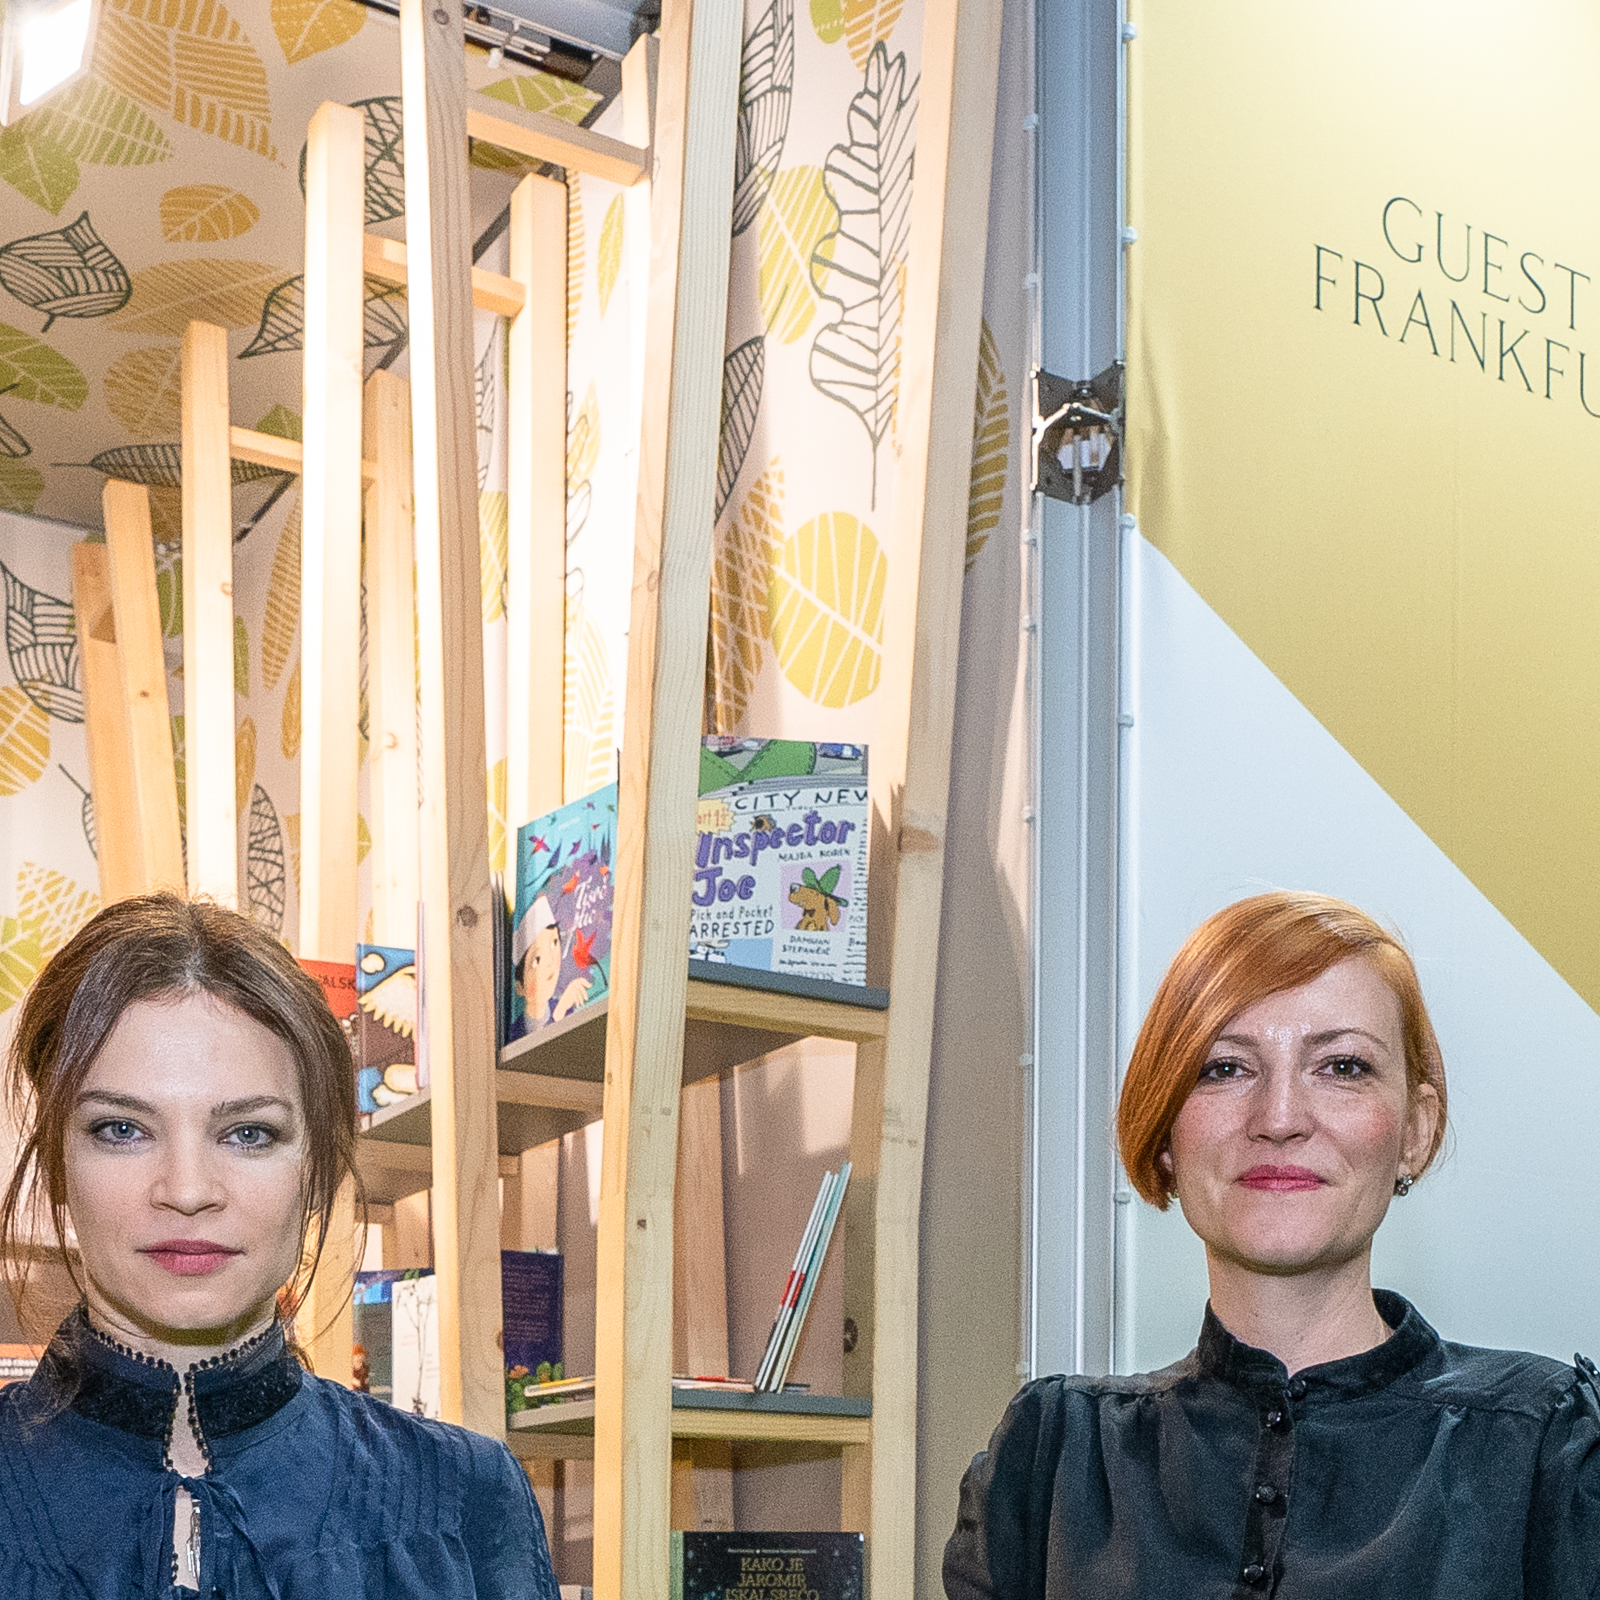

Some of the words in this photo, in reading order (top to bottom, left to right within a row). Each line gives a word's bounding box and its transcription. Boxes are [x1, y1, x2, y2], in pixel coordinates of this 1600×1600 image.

[1382, 196, 1592, 331] GUEST
[734, 790, 800, 810] CITY
[695, 810, 856, 868] Inspector
[692, 866, 757, 907] Joe
[716, 907, 735, 920] and
[738, 904, 774, 919] Pocket
[689, 919, 775, 938] ARRESTED
[740, 1557, 784, 1573] KAKO
[785, 1557, 805, 1573] JE
[736, 1572, 808, 1590] JAROMIR
